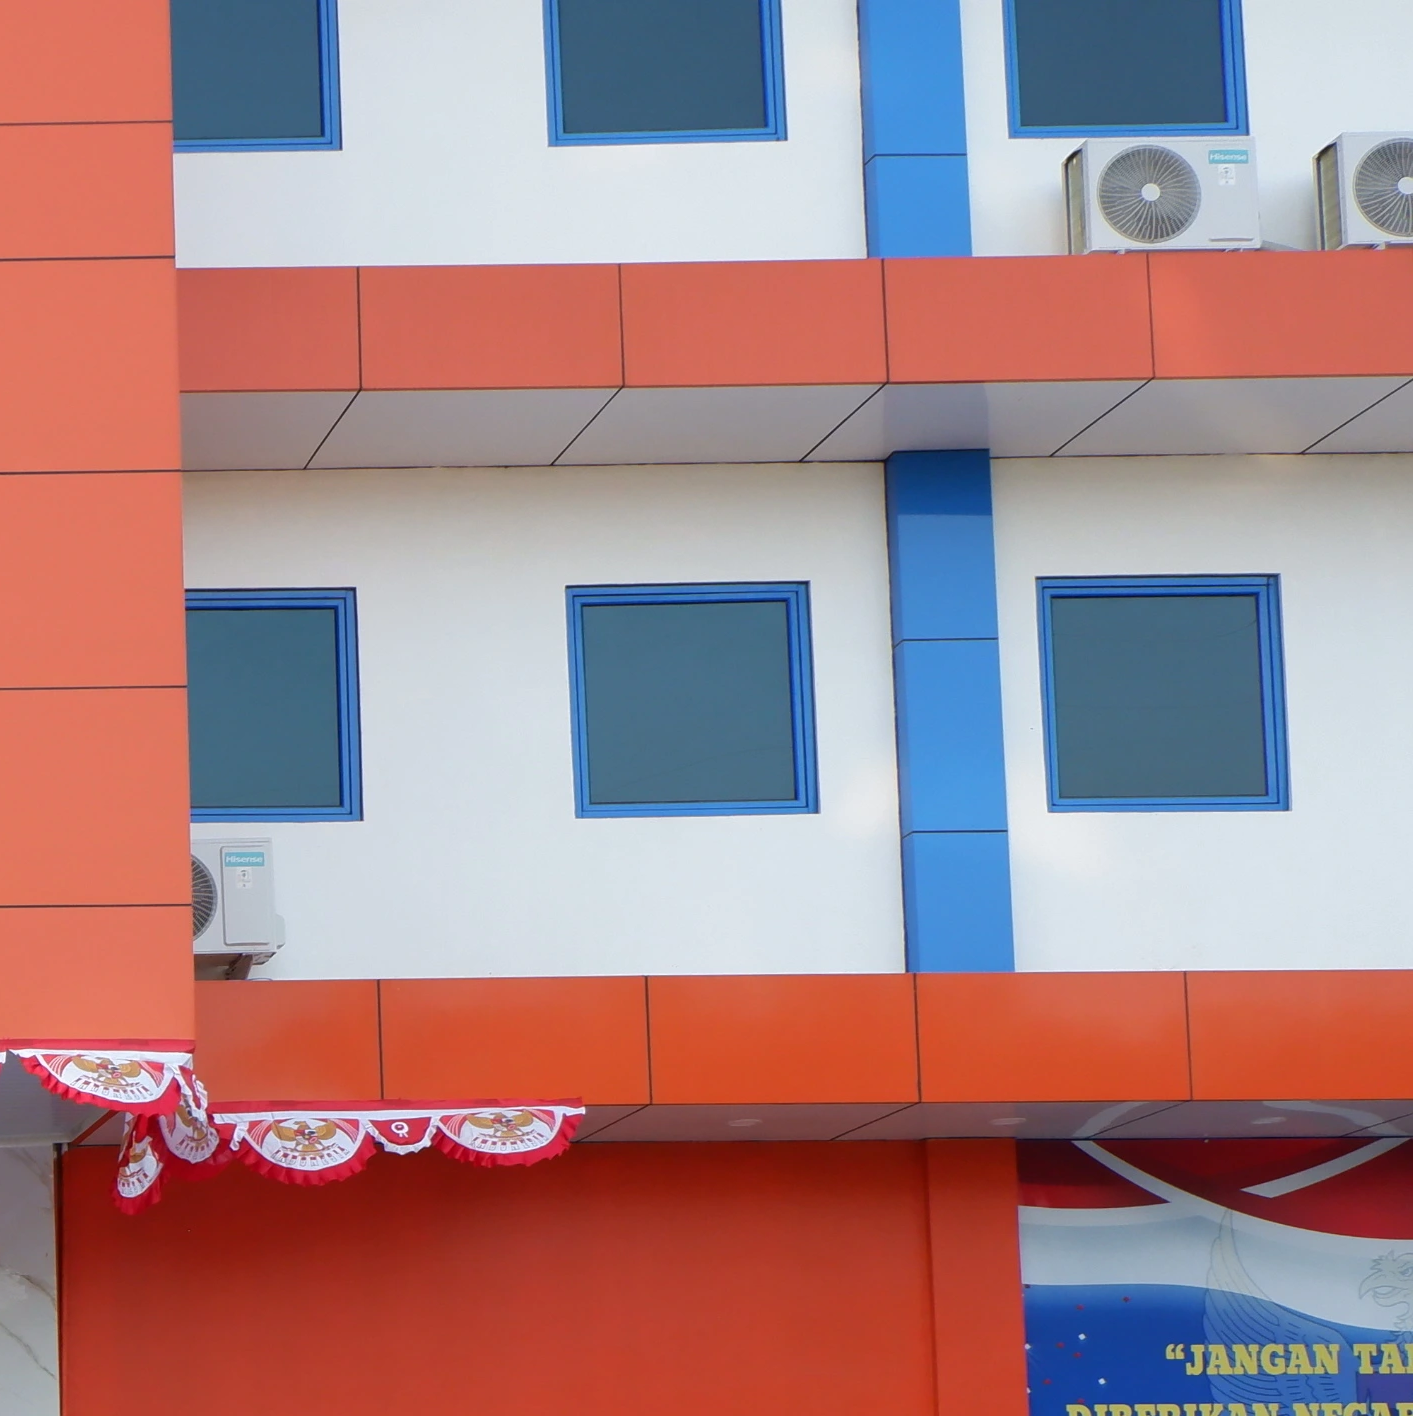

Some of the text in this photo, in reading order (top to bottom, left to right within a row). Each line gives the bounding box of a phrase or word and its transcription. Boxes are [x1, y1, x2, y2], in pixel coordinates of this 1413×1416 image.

[1209, 152, 1248, 162] Hisense
[225, 855, 263, 864] Hisense
[1166, 1343, 1341, 1375] “JANGAN
